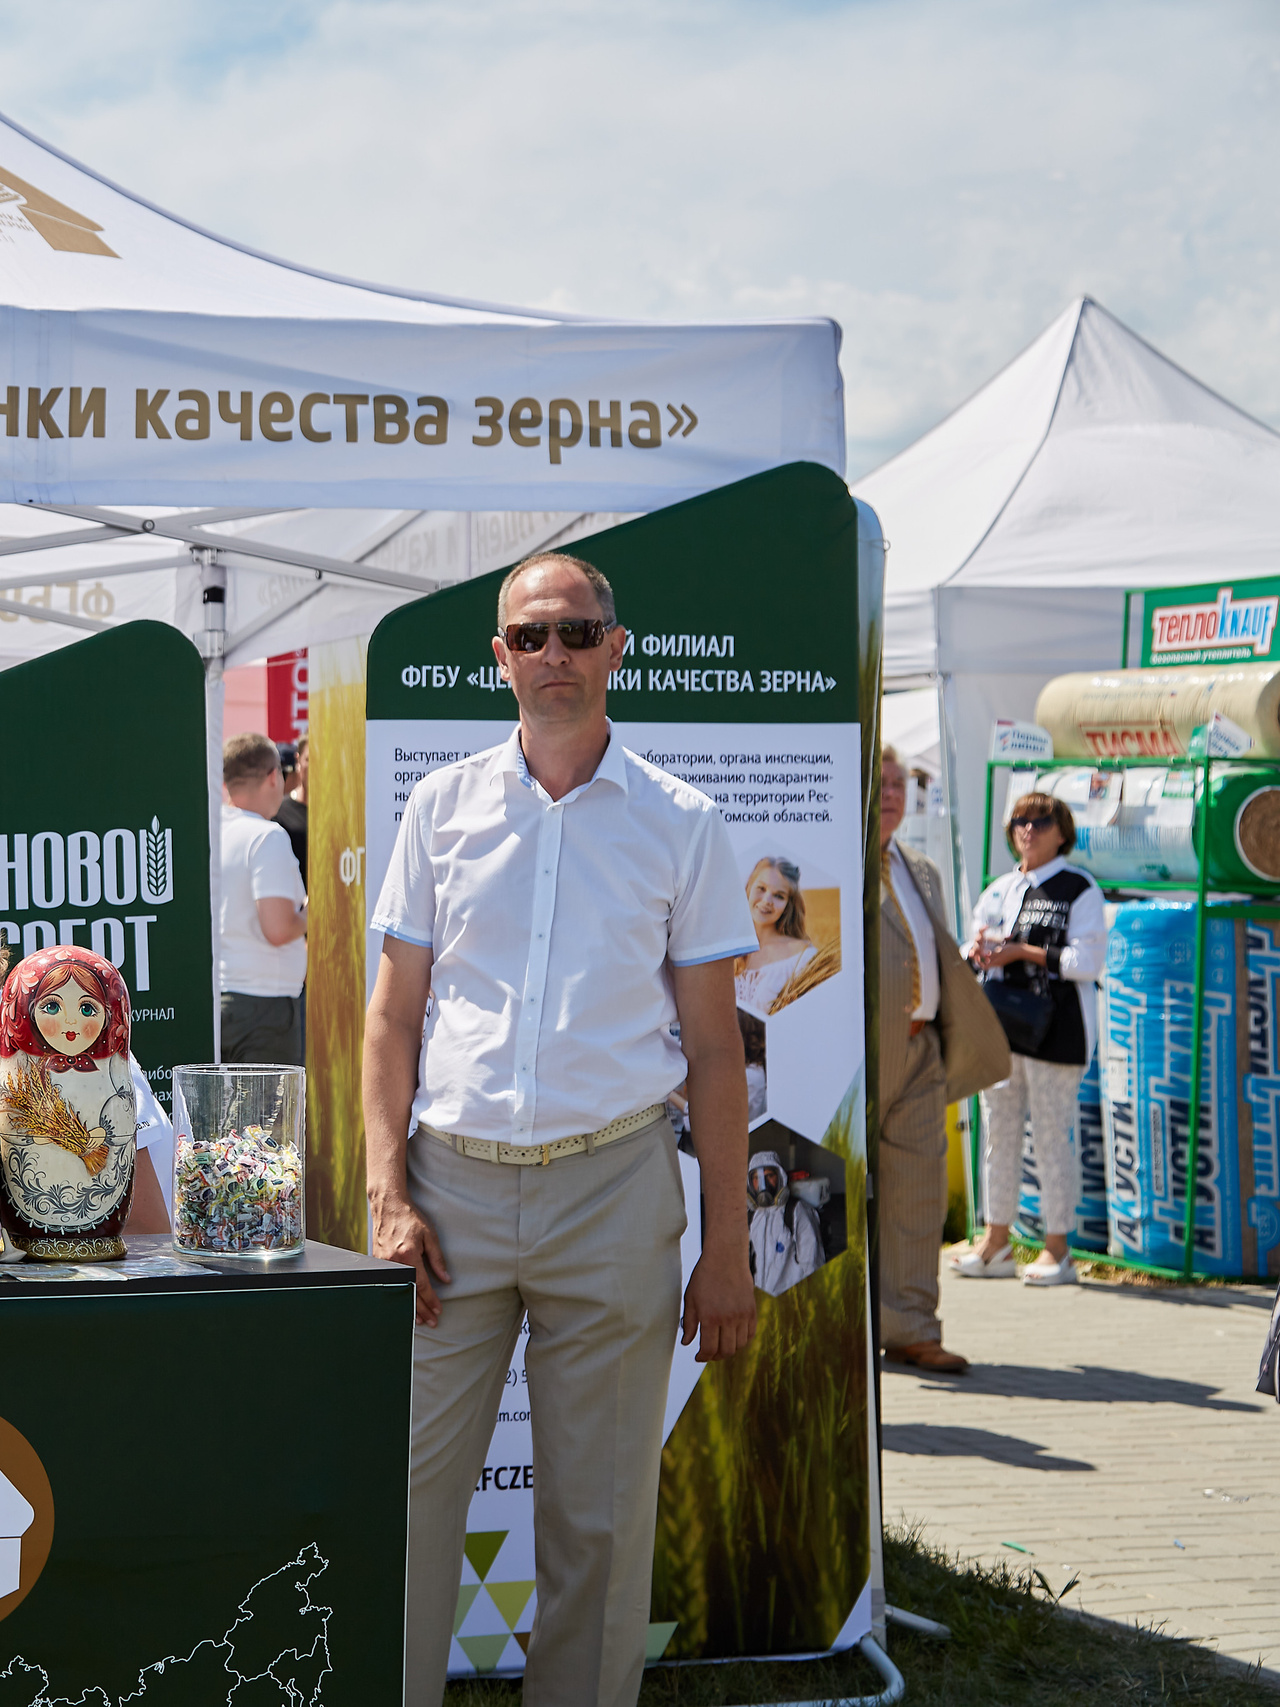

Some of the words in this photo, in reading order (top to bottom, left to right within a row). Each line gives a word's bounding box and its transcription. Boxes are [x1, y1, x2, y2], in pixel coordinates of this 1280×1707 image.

[135, 387, 449, 446] качества
[472, 396, 698, 465] зерна»
[641, 633, 734, 657] ФИЛИАЛ
[402, 665, 461, 689] ФГБУ
[649, 669, 754, 693] КАЧЕСТВА
[760, 670, 837, 693] ЗЕРНА»
[394, 748, 460, 765] Выступает
[720, 753, 761, 767] органа
[766, 753, 834, 765] инспекции,
[749, 773, 833, 786] подкарантин-
[714, 794, 729, 803] на
[733, 793, 804, 807] территории
[808, 789, 834, 803] Рес-
[773, 808, 833, 823] областей.
